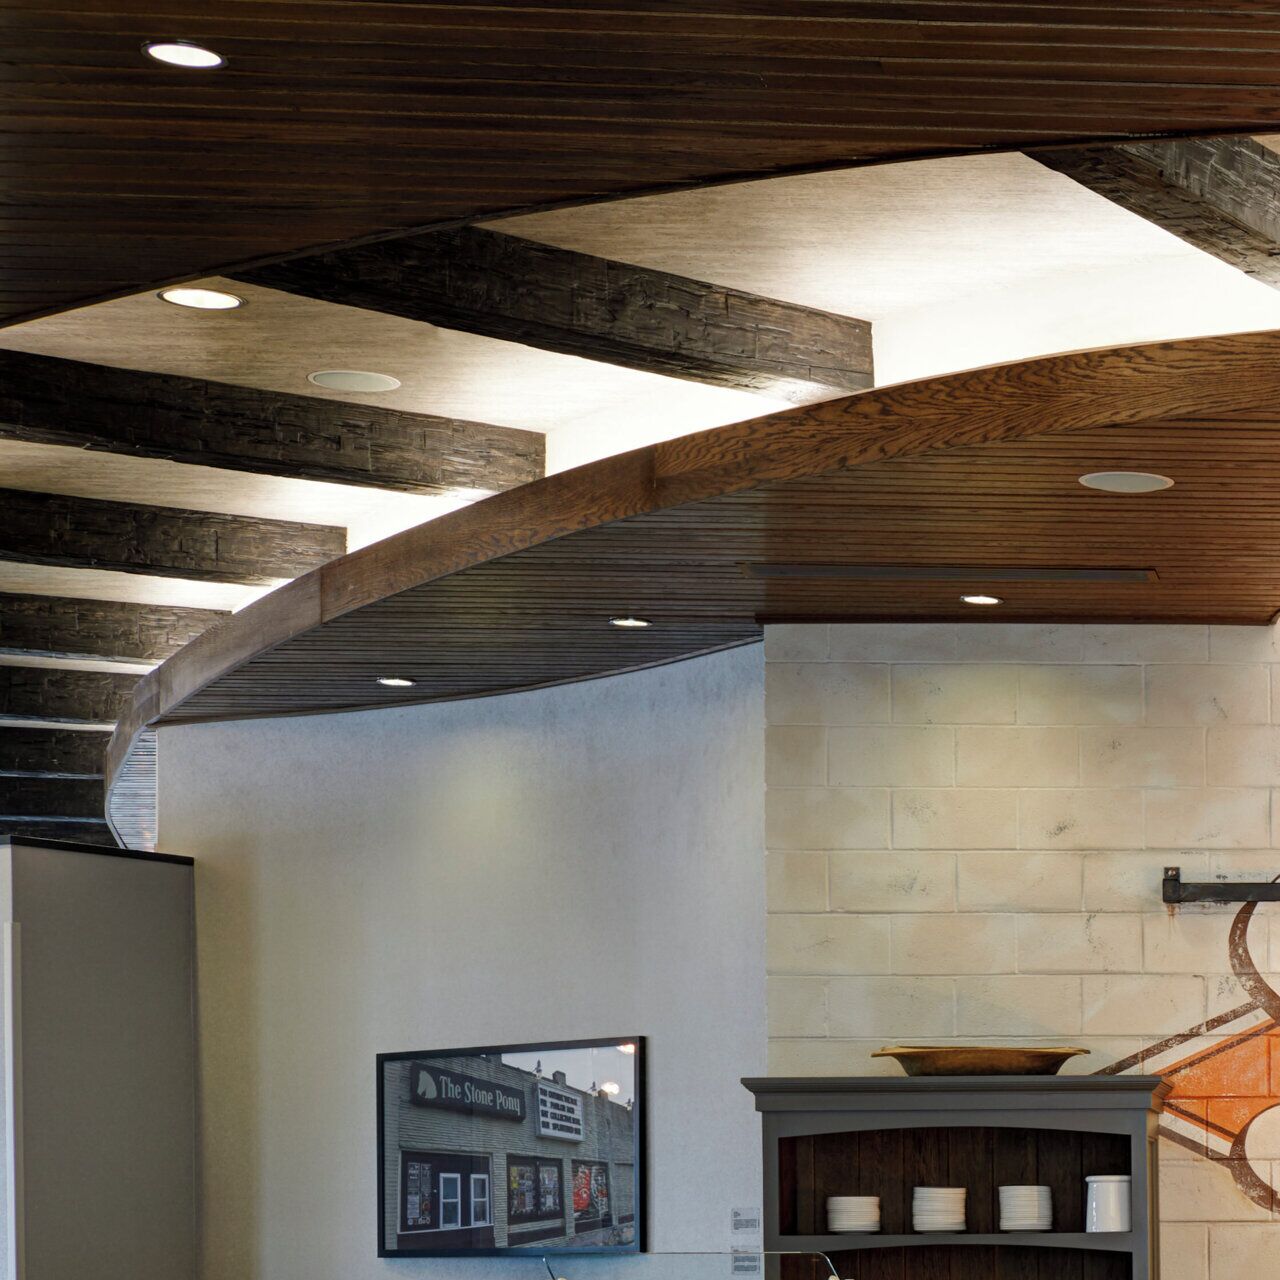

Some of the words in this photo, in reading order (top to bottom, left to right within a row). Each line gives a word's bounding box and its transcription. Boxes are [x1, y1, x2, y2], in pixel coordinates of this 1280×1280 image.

[440, 1075, 462, 1099] The
[464, 1082, 493, 1105] Stone
[495, 1089, 521, 1116] Pony
